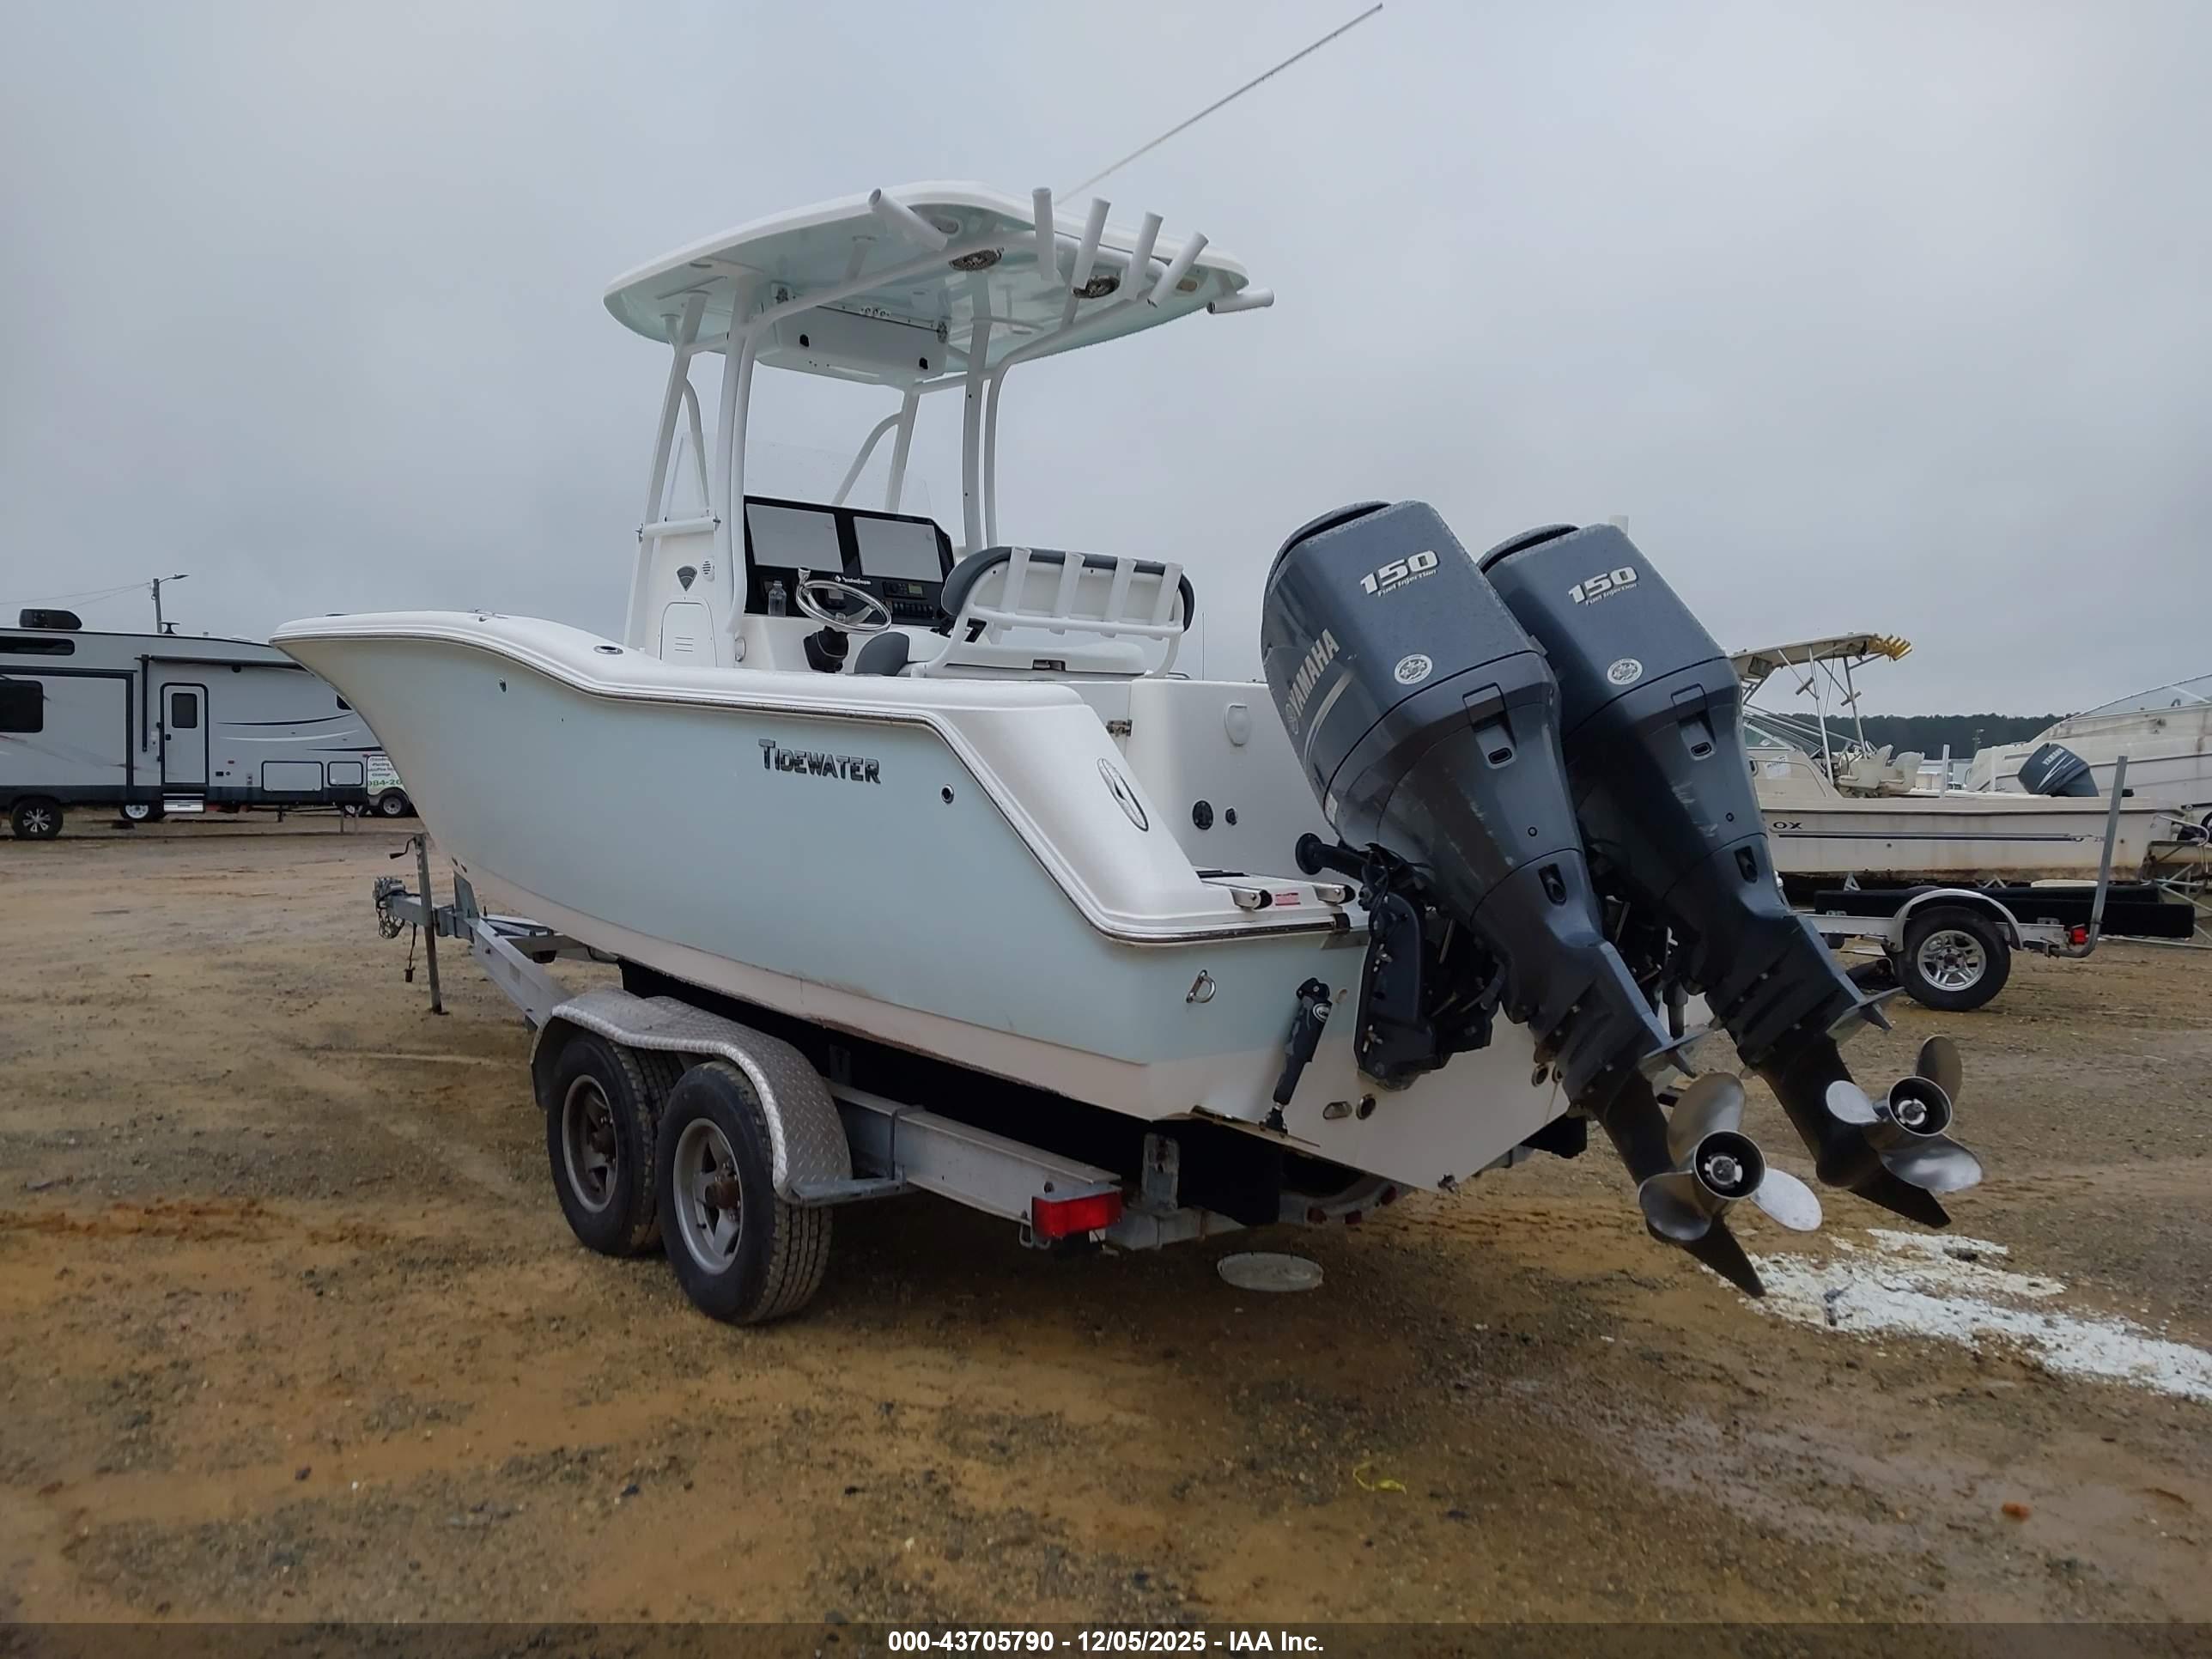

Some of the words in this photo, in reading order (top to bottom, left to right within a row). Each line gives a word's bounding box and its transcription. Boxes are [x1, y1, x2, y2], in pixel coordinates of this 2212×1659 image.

[1360, 550, 1438, 595] 150
[1568, 566, 1638, 604] 150
[1288, 628, 1340, 718] YAMAHA
[758, 738, 881, 785] TIDEWATER
